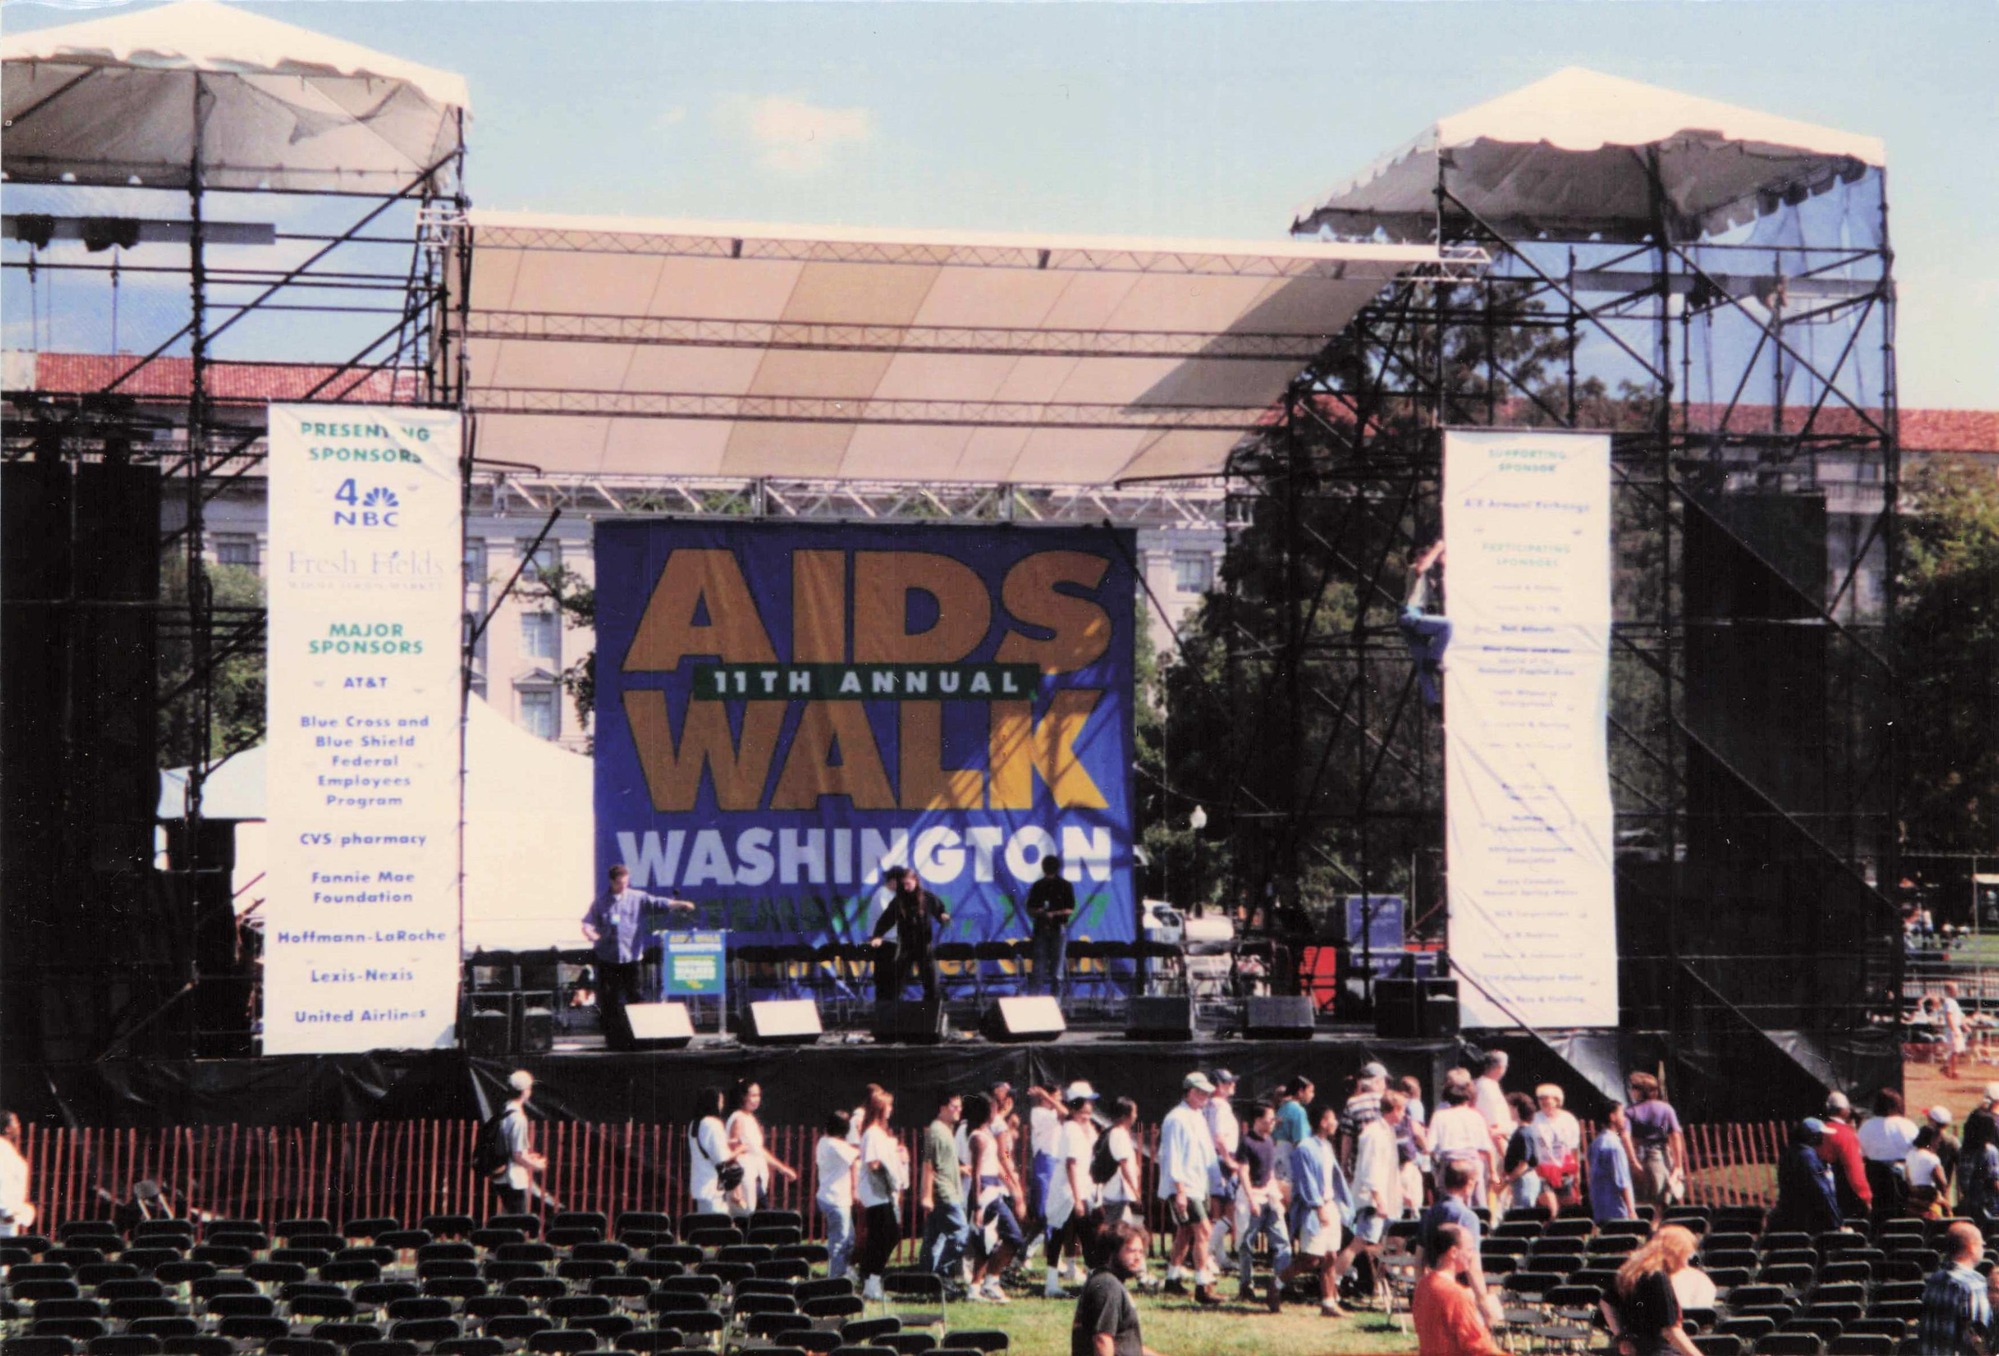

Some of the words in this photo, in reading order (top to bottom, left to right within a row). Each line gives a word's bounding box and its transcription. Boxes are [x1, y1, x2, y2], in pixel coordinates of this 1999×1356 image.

[334, 478, 359, 506] 4
[334, 511, 399, 527] NBC
[289, 550, 357, 574] Fresh
[372, 550, 444, 575] Fields
[621, 548, 1112, 675] AIDS
[329, 623, 404, 637] MAJOR
[308, 640, 424, 654] SPONSORS
[343, 677, 388, 688] AT&T
[714, 670, 812, 694] 11TH
[839, 670, 1019, 694] ANNUAL
[300, 716, 338, 727] Blue
[346, 716, 391, 727] Cross
[397, 715, 430, 727] and
[315, 736, 353, 747] Blue
[361, 735, 416, 747] Shield
[622, 689, 1110, 812] WALK
[332, 755, 399, 767] Federal
[318, 775, 411, 789] Employees
[326, 795, 403, 809] Program
[300, 833, 332, 845] CVS
[341, 833, 427, 848] pharmacy
[616, 825, 1112, 887] WASHINGTON
[311, 871, 371, 883] Fannie
[378, 871, 415, 883] Mae
[313, 891, 413, 903] Foundation
[278, 930, 446, 943] Hoffmann-LaRoche
[311, 968, 414, 983] Lexis-Nexis
[294, 1010, 354, 1022] United
[361, 1009, 426, 1021] Airlins
